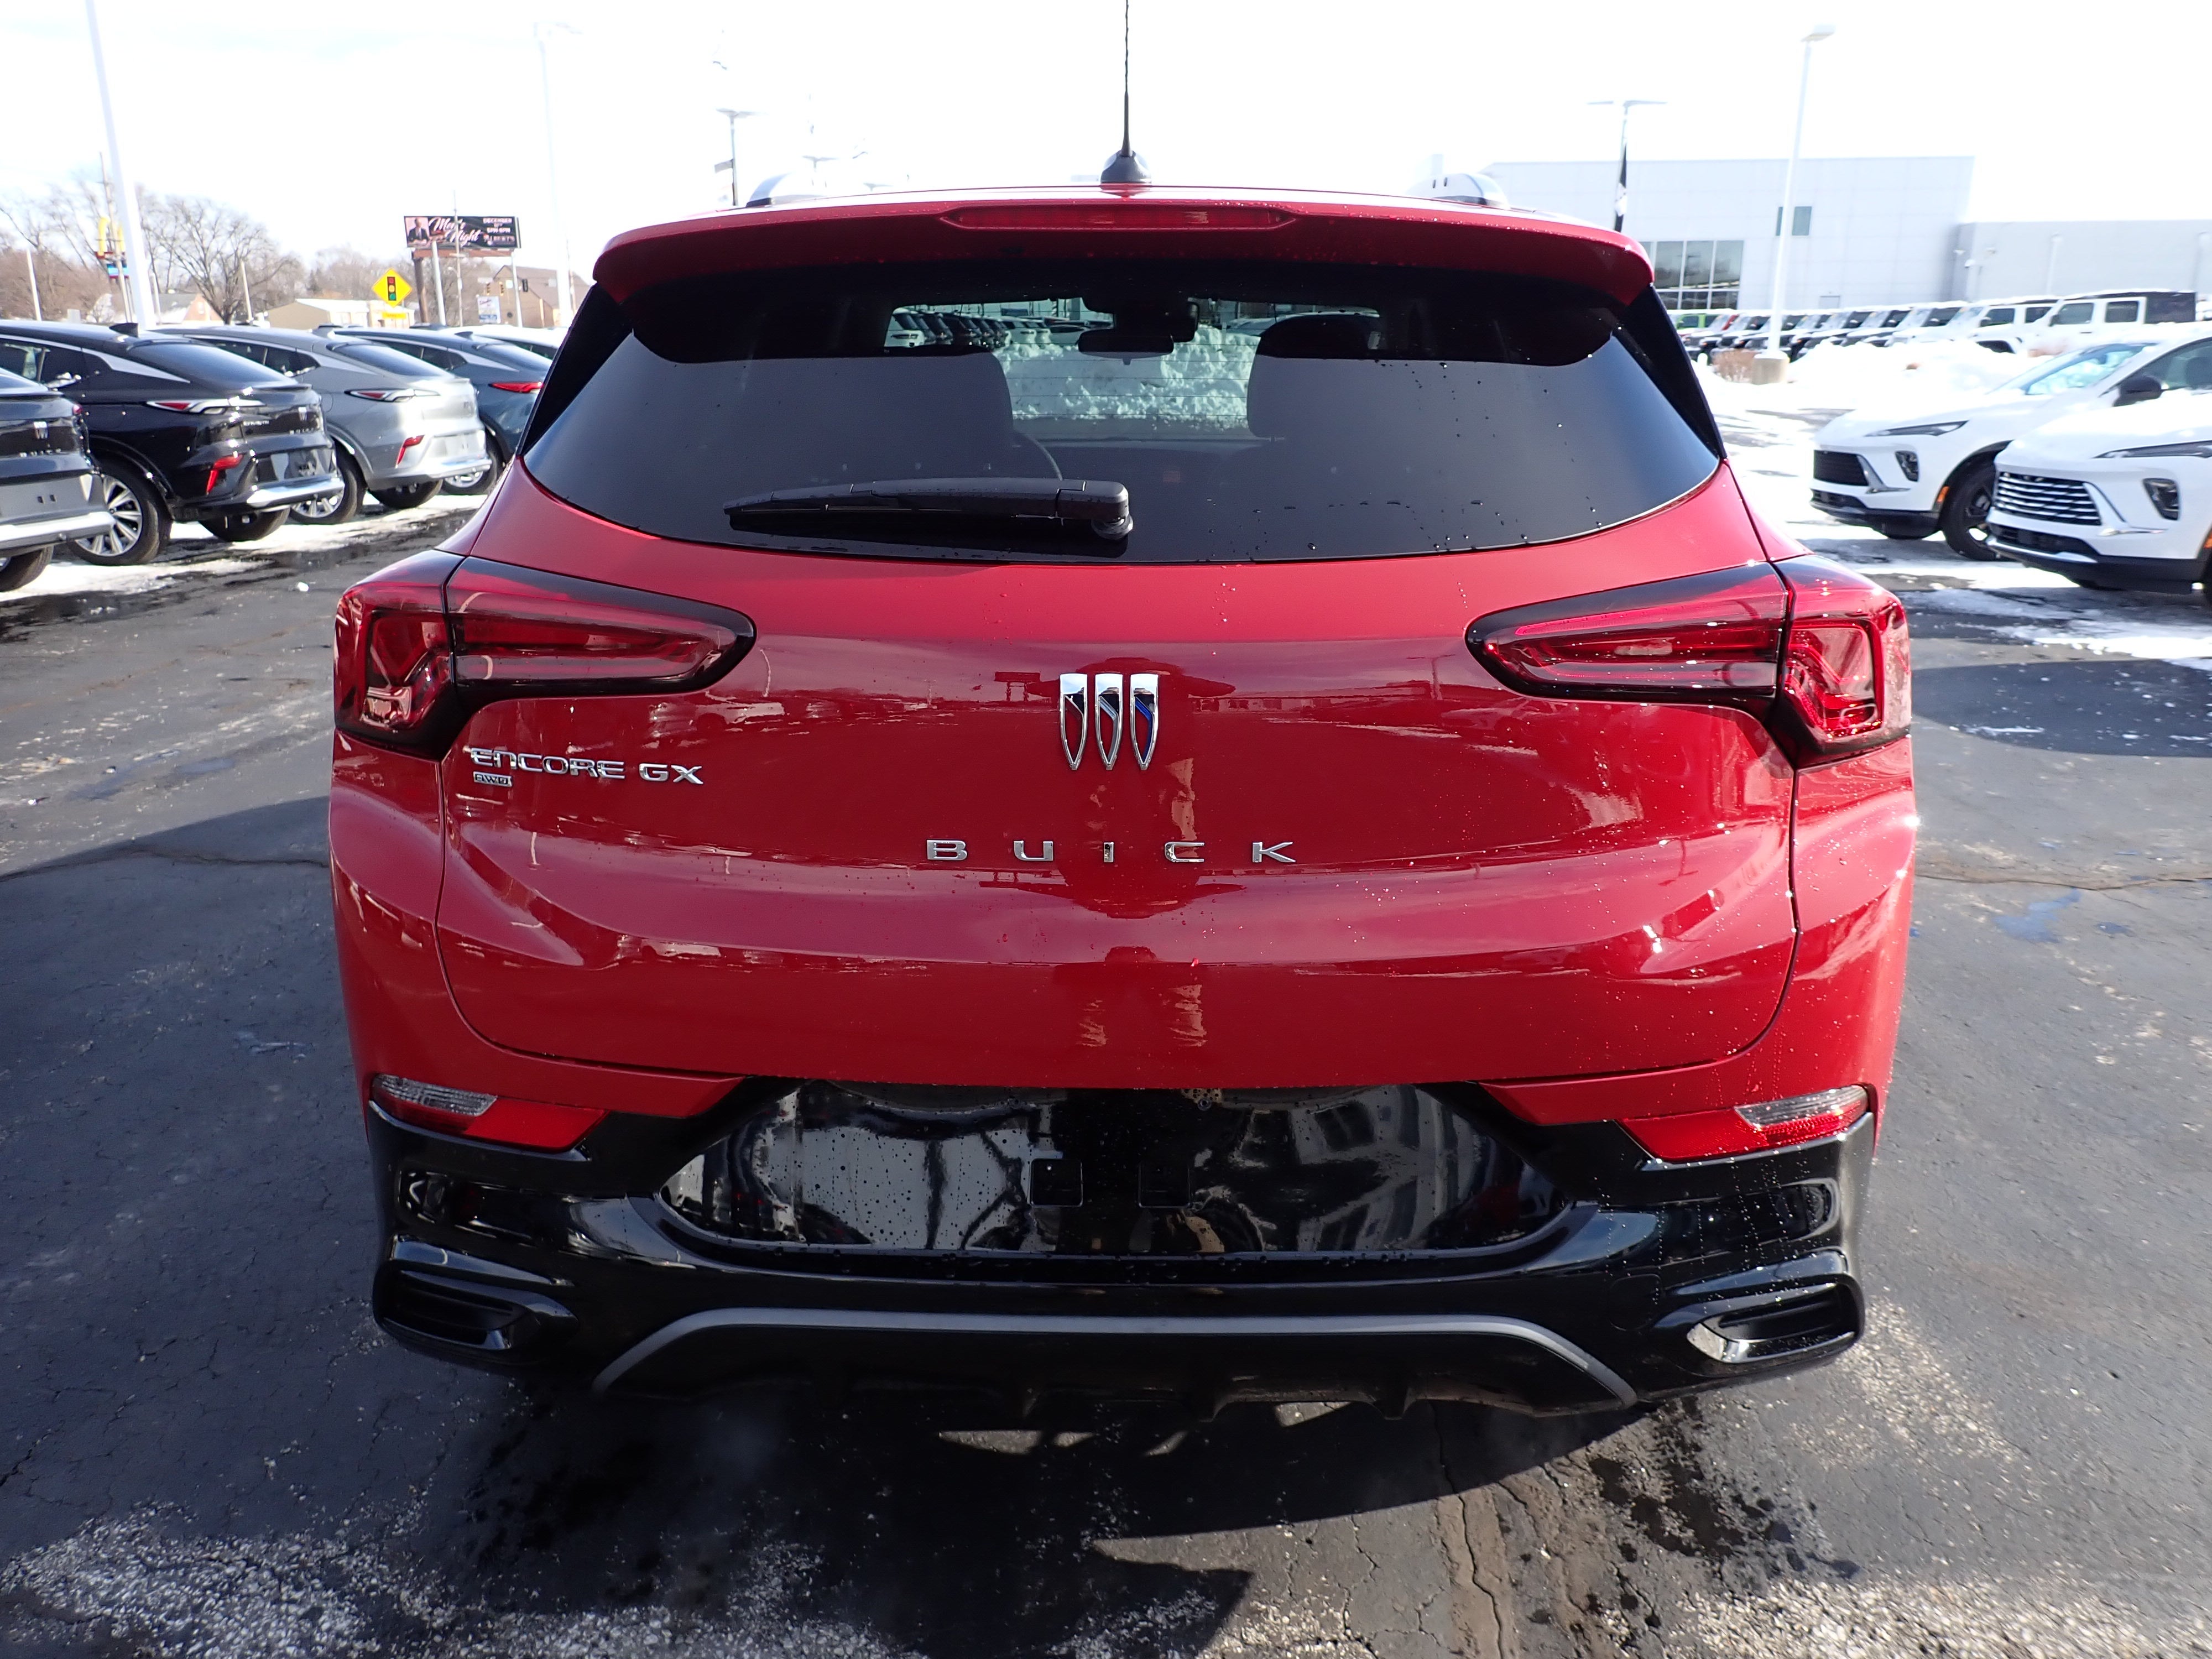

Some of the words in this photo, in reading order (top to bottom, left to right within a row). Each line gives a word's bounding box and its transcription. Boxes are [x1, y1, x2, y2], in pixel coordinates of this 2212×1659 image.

[470, 748, 625, 779] ENCORE
[639, 763, 703, 785] GX
[474, 773, 509, 785] AWD
[926, 839, 1297, 865] BUICK
